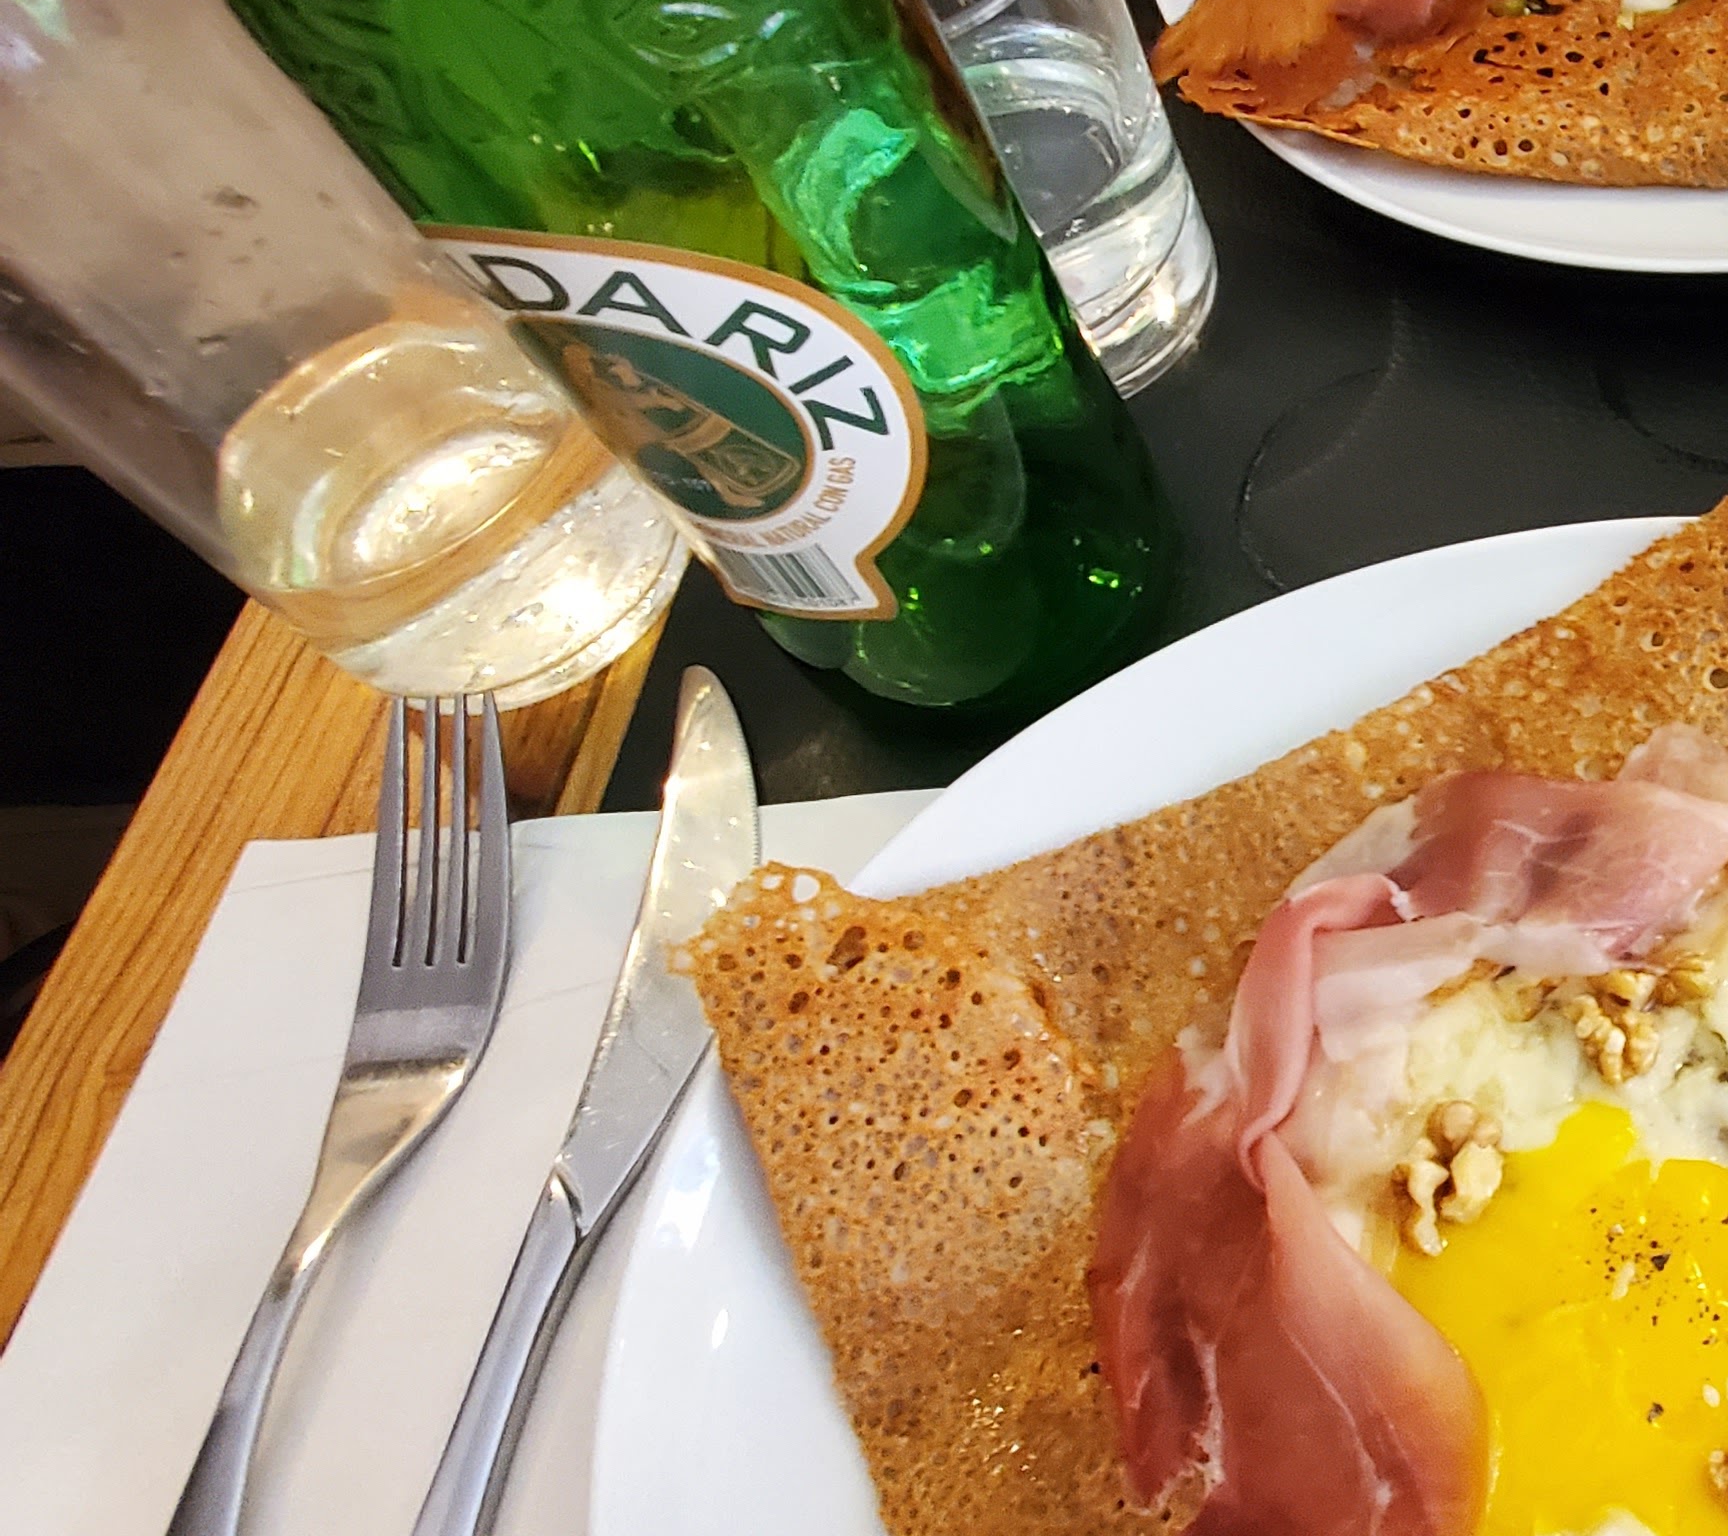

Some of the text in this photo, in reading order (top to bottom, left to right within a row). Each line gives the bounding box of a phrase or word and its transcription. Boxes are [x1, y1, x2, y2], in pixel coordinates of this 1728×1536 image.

[467, 253, 890, 452] DARIZ
[826, 456, 857, 485] GAS
[813, 484, 849, 513] CON
